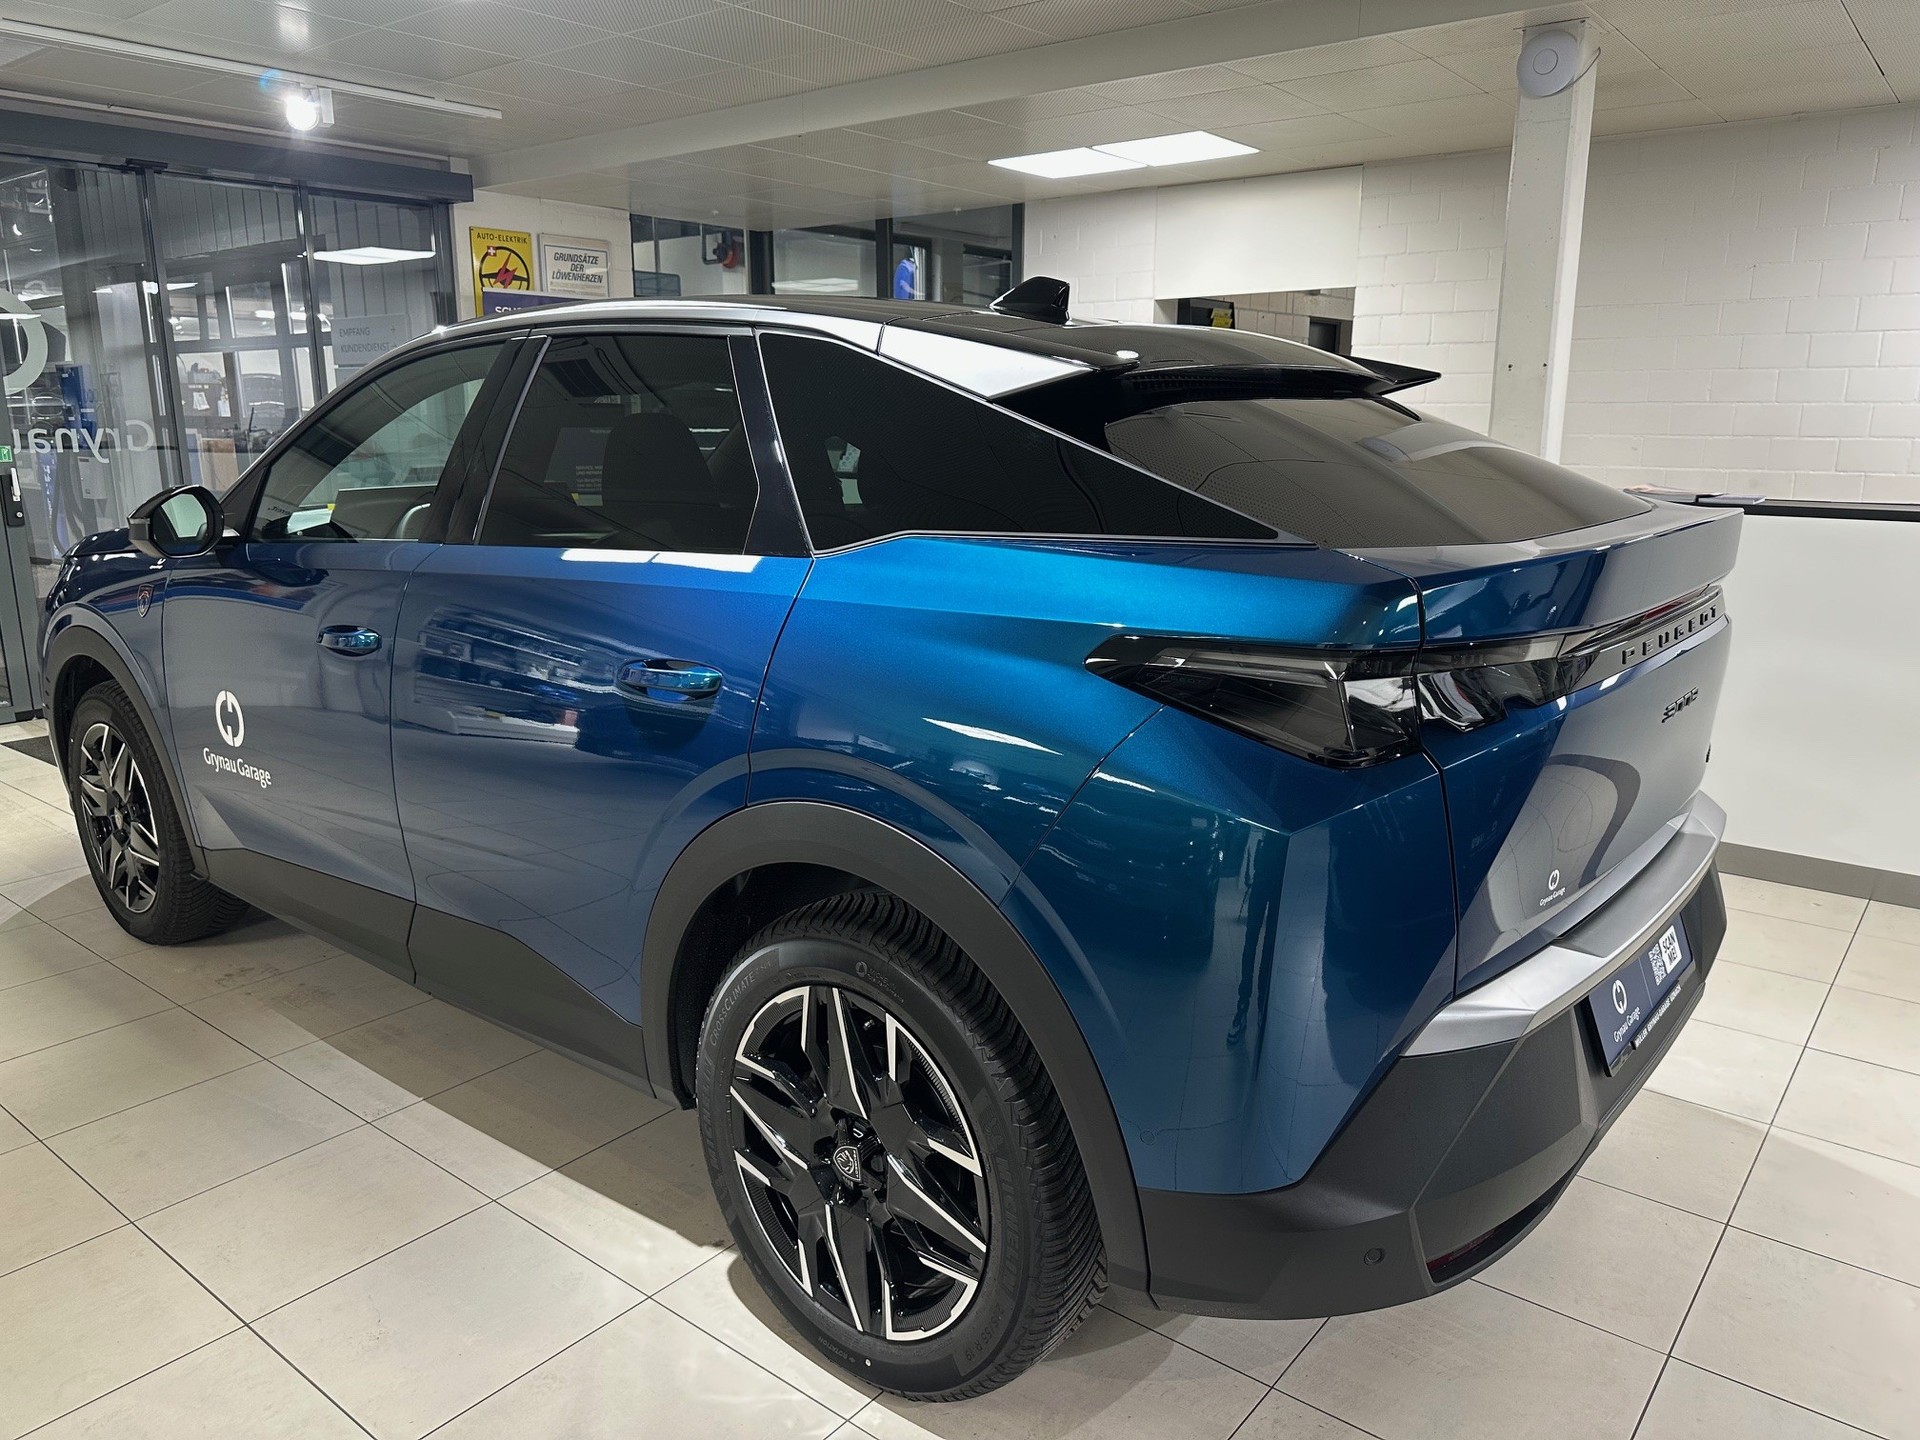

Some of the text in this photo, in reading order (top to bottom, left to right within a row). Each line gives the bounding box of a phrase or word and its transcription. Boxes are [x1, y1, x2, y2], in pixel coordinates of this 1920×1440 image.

[476, 232, 528, 244] AUTO-ELEKTRIK
[553, 252, 600, 265] GRUNDSÄTZE
[569, 263, 585, 272] DER
[551, 269, 604, 283] LÖWENHERZEN
[339, 327, 370, 337] EMPFANG
[340, 342, 391, 353] KUNDENDIENST
[1621, 604, 1717, 665] PEUGEOT
[203, 747, 272, 788] Grynau Garage
[1662, 931, 1676, 954] SCAN
[1613, 1006, 1641, 1042] Grynau Garage
